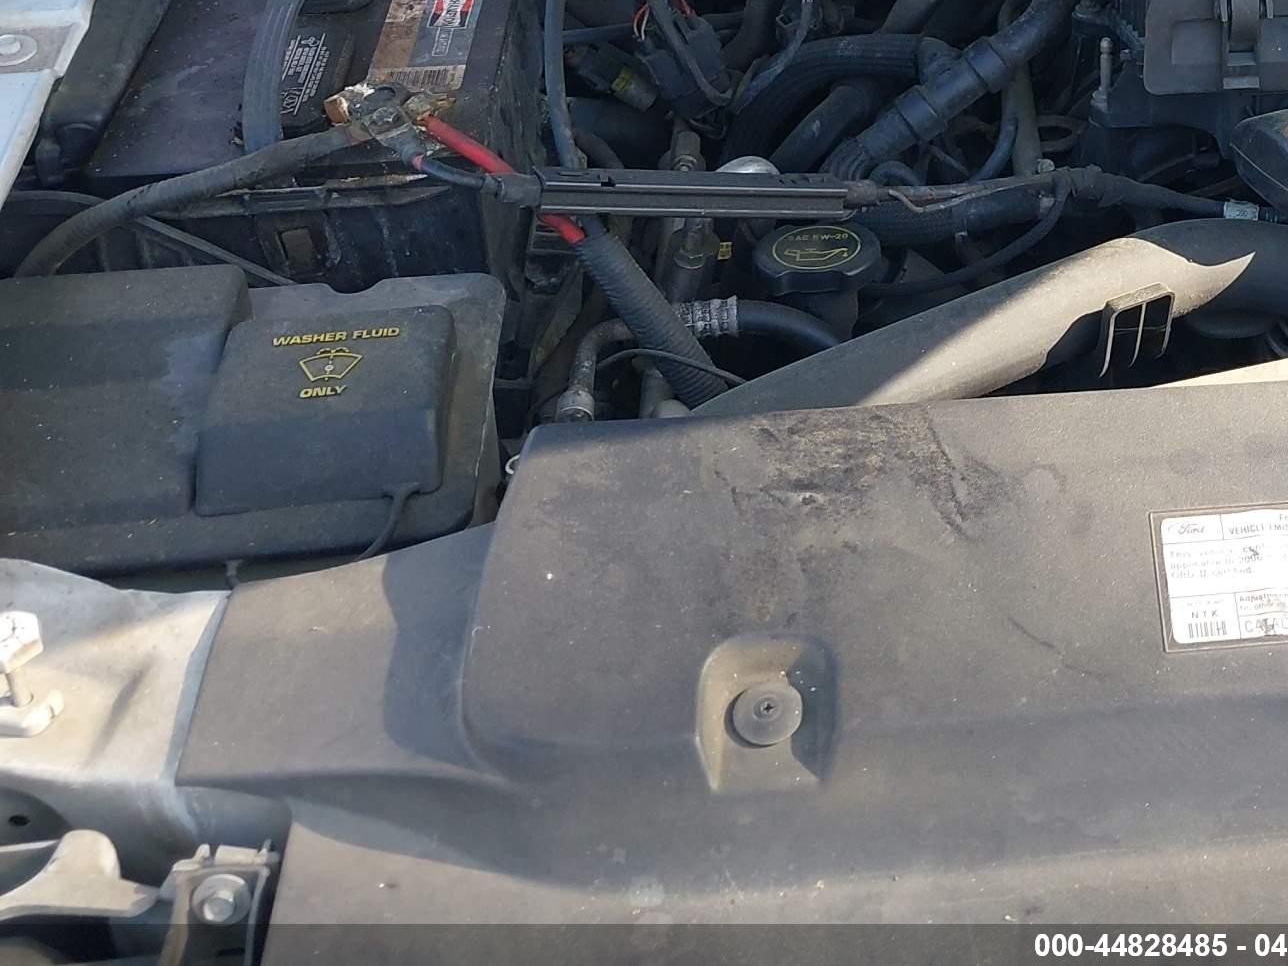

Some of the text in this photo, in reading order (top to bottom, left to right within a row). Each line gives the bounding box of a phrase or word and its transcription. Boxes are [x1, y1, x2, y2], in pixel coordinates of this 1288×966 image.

[272, 327, 400, 346] WASHER FLUID
[300, 384, 347, 398] ONLY
